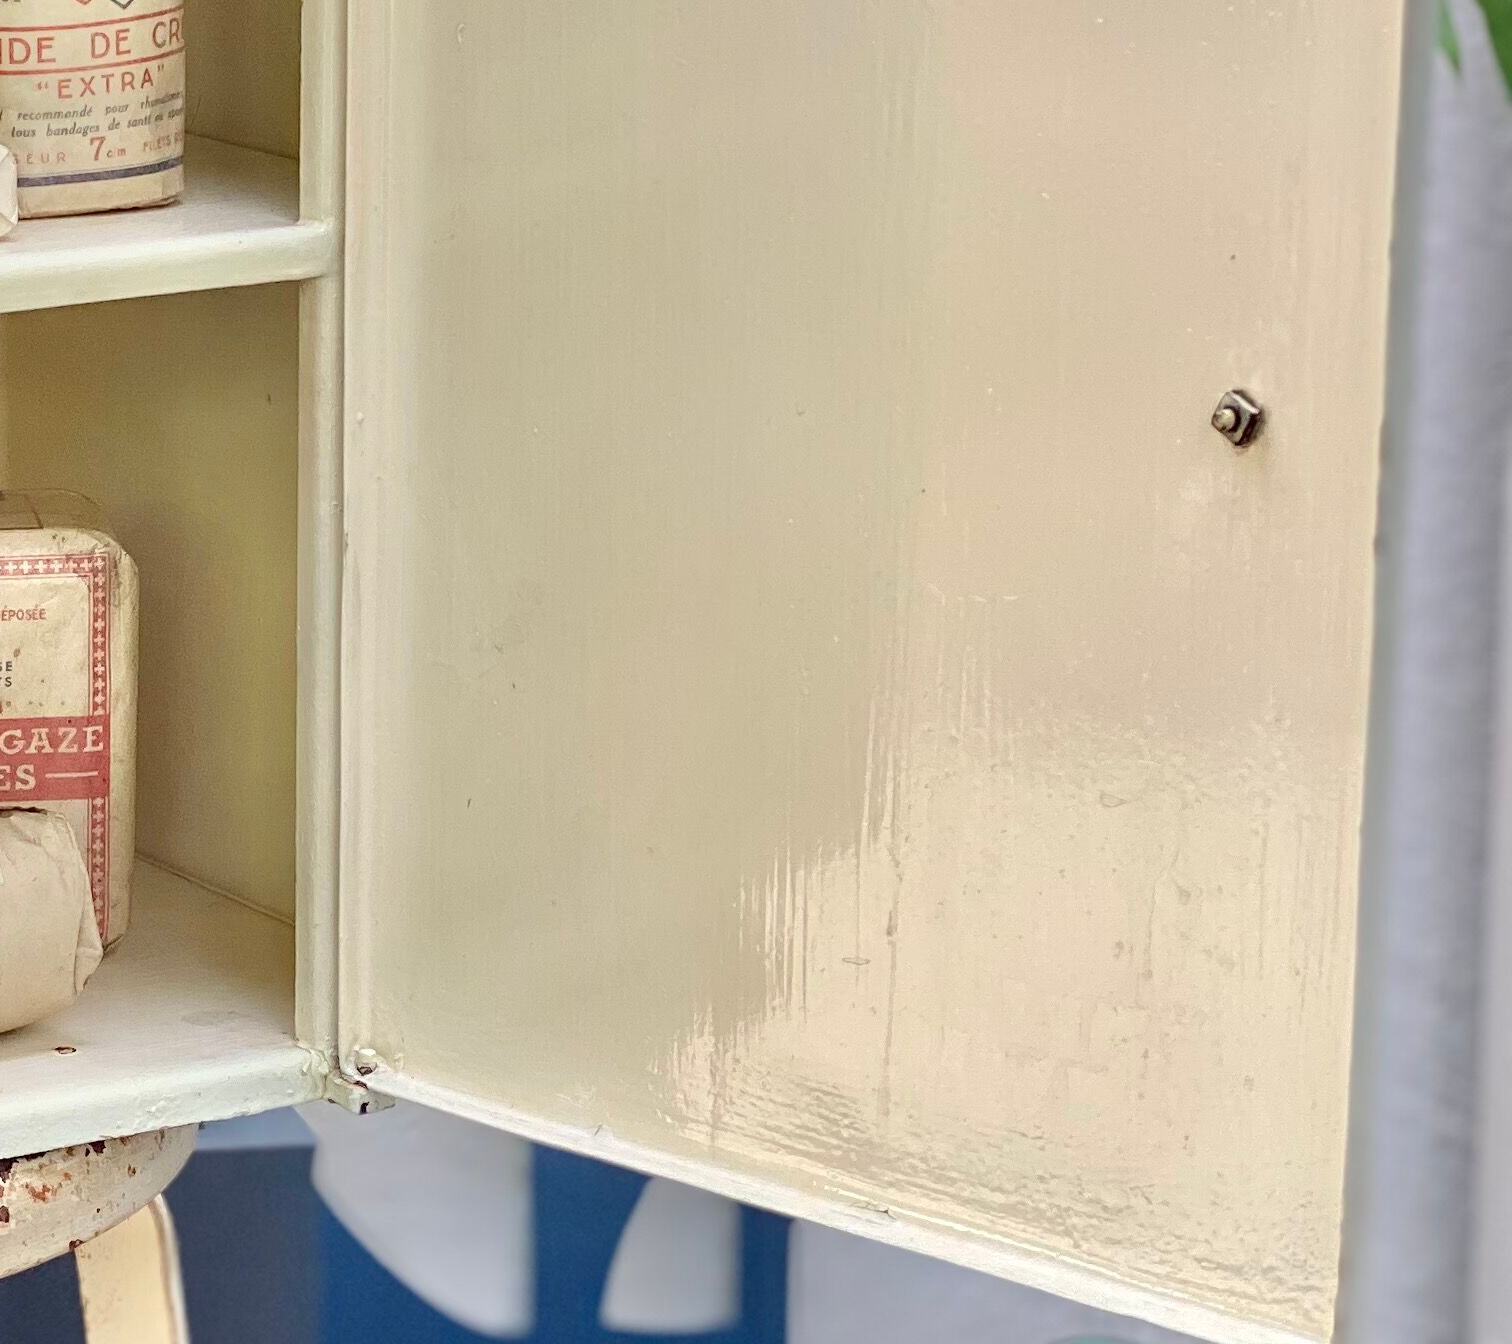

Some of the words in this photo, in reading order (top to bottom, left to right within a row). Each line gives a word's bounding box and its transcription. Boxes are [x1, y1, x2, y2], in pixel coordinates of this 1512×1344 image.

[90, 27, 132, 59] DE
[17, 105, 93, 121] recommandé
[104, 103, 129, 116] pour
[11, 126, 36, 138] tous
[46, 122, 100, 139] bandages
[107, 117, 120, 131] de
[90, 136, 106, 162] 7
